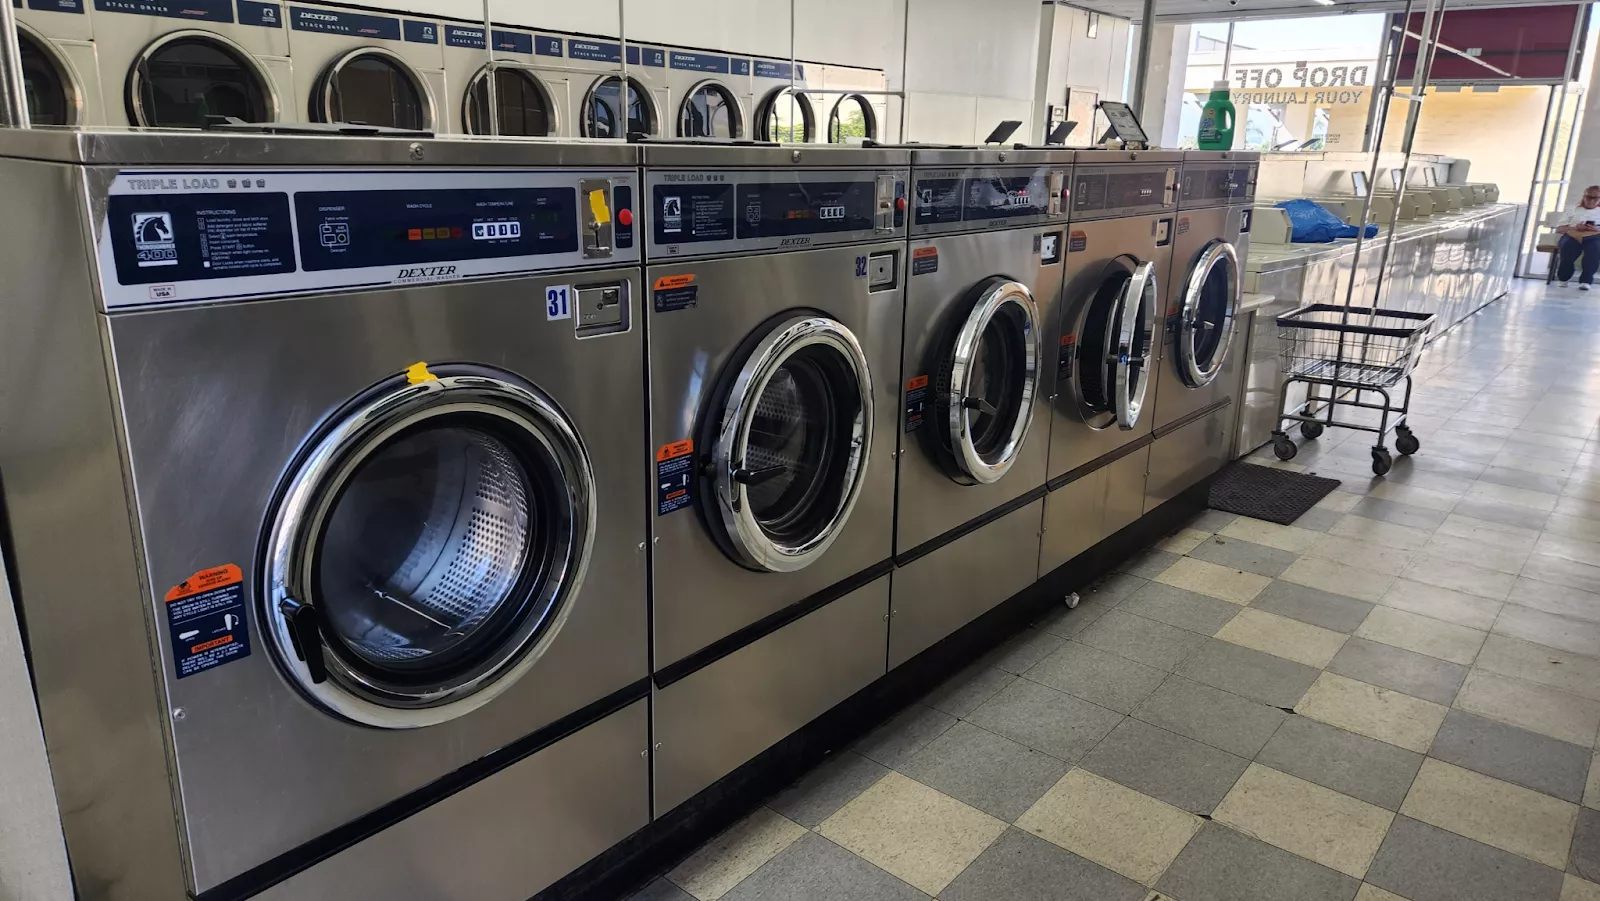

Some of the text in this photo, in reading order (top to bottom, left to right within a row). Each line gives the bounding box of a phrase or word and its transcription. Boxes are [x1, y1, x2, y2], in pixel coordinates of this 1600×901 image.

[300, 12, 338, 22] DEXTER
[452, 30, 482, 38] DEXTER
[128, 178, 220, 190] TRIPLE LOAD
[137, 250, 177, 260] 400
[398, 266, 457, 279] DEXTER
[856, 256, 867, 277] 32
[548, 289, 567, 316] 31
[199, 568, 228, 580] WARNING
[194, 636, 229, 651] IMPORTANT
